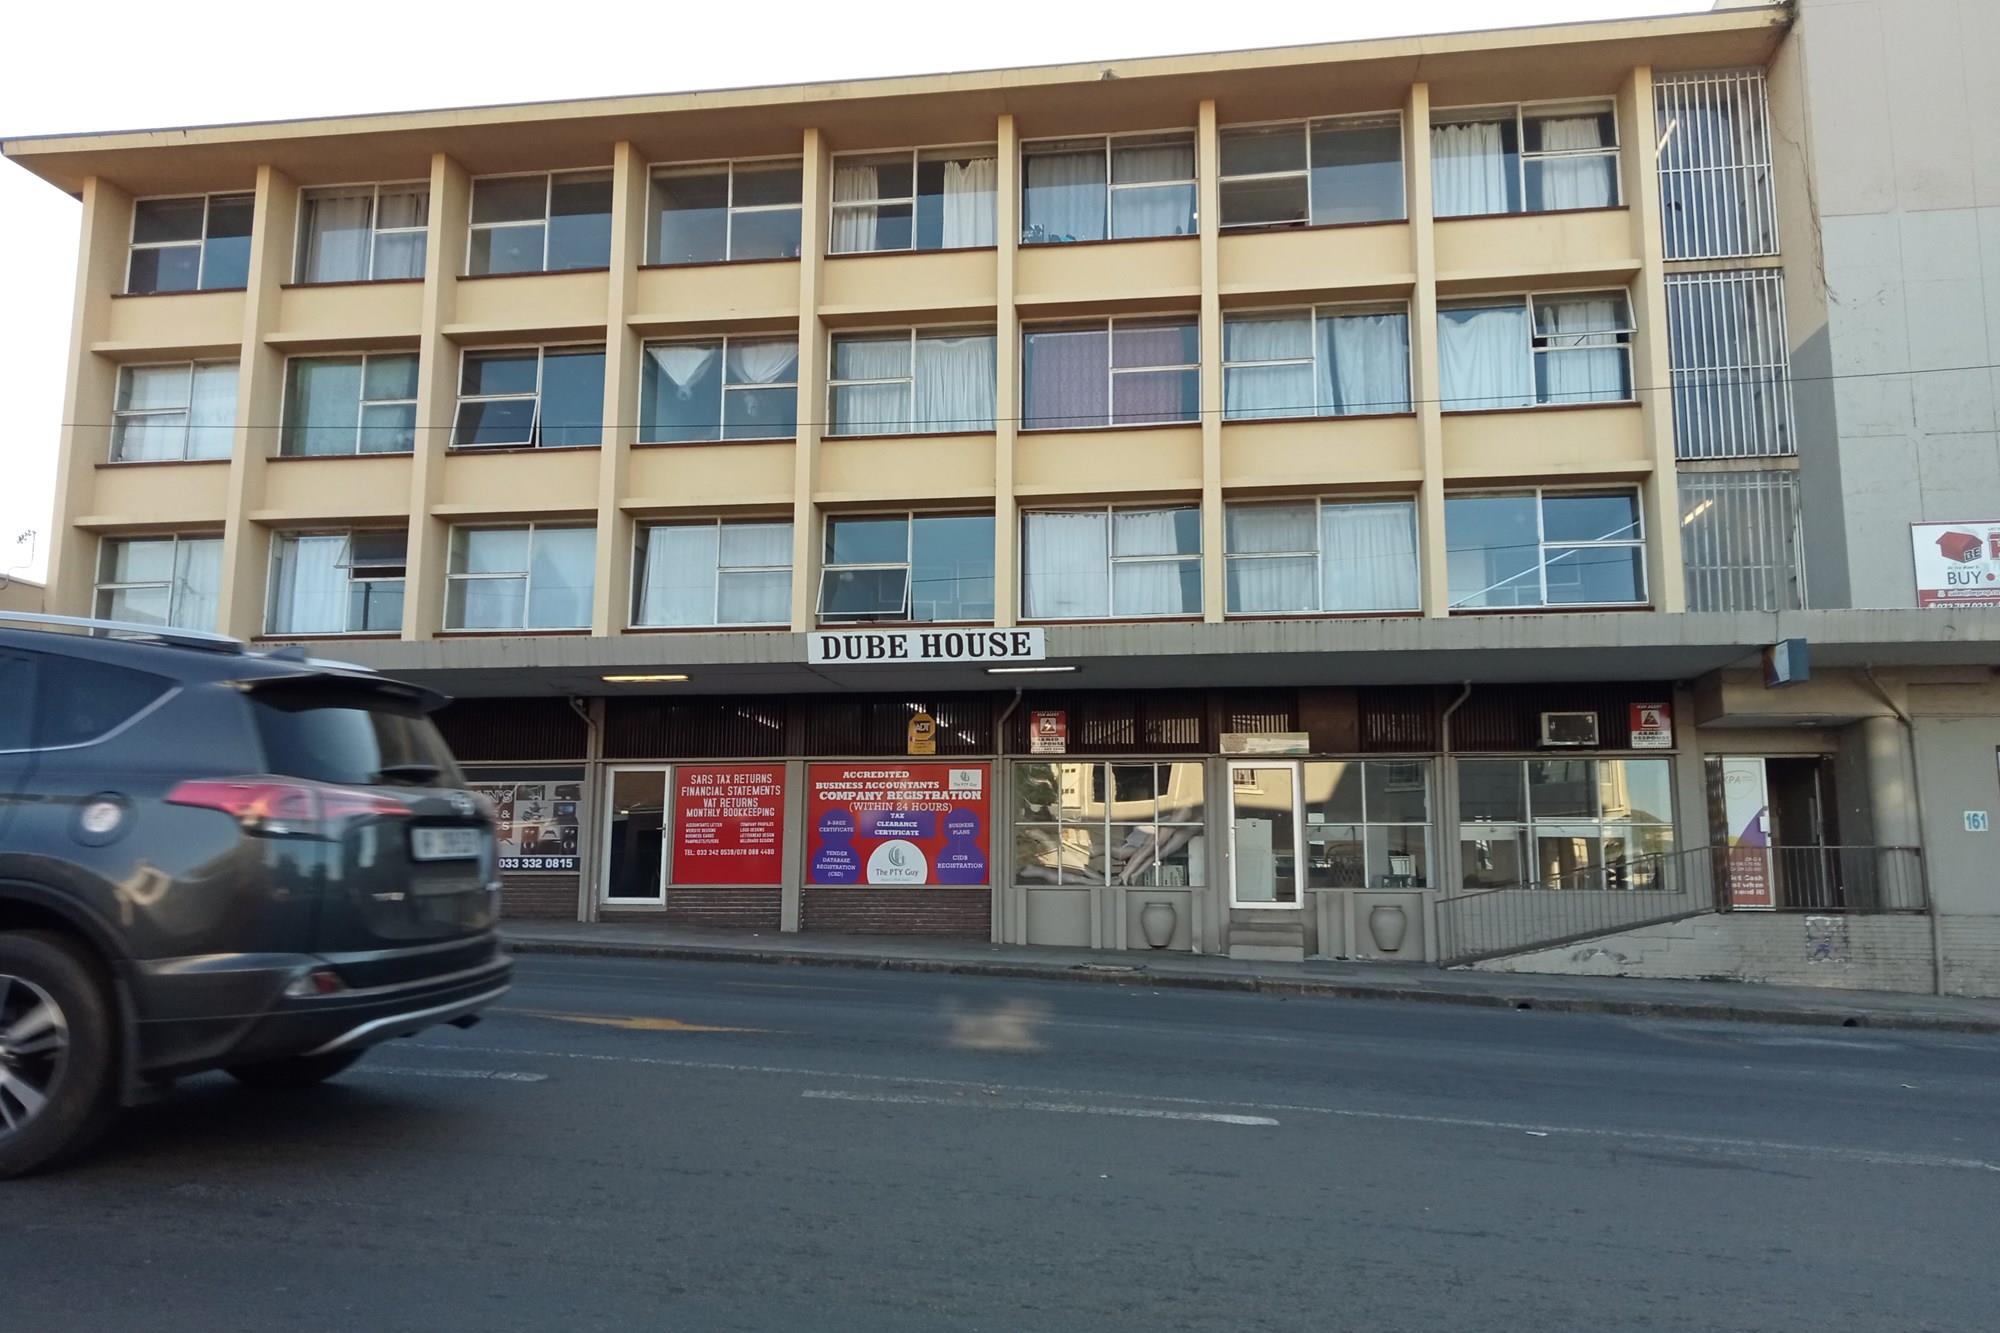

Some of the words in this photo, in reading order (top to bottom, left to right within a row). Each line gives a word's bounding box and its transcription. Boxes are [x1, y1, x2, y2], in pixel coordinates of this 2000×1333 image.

[1947, 571, 1981, 585] BUY
[820, 634, 908, 660] DUBE
[920, 631, 1032, 658] HOUSE
[690, 774, 713, 784] SARS
[716, 774, 730, 784] TAX
[734, 773, 772, 784] RETURNS
[842, 771, 910, 779] ACCREDITED
[681, 786, 725, 796] FINANCIAL
[728, 785, 781, 796] STATEMENTS
[815, 782, 864, 790] BUSINESS
[864, 781, 940, 790] ACCOUNTANTS
[819, 791, 884, 801] COMPANY
[886, 790, 982, 800] REGISTRATION
[703, 798, 718, 808] VAT
[720, 798, 758, 808] RETURNS
[849, 802, 894, 813] (WITHIN
[896, 803, 908, 811] 24
[912, 802, 953, 813] HOURS)
[686, 808, 720, 817] MONTHLY
[723, 808, 775, 817] BOOKKEEPING
[1966, 813, 1986, 830] 161
[498, 858, 519, 869] 033
[521, 858, 542, 868] 332
[545, 858, 573, 868] 0815
[875, 868, 888, 876] The
[889, 868, 903, 876] PTY
[904, 868, 919, 876] Guy
